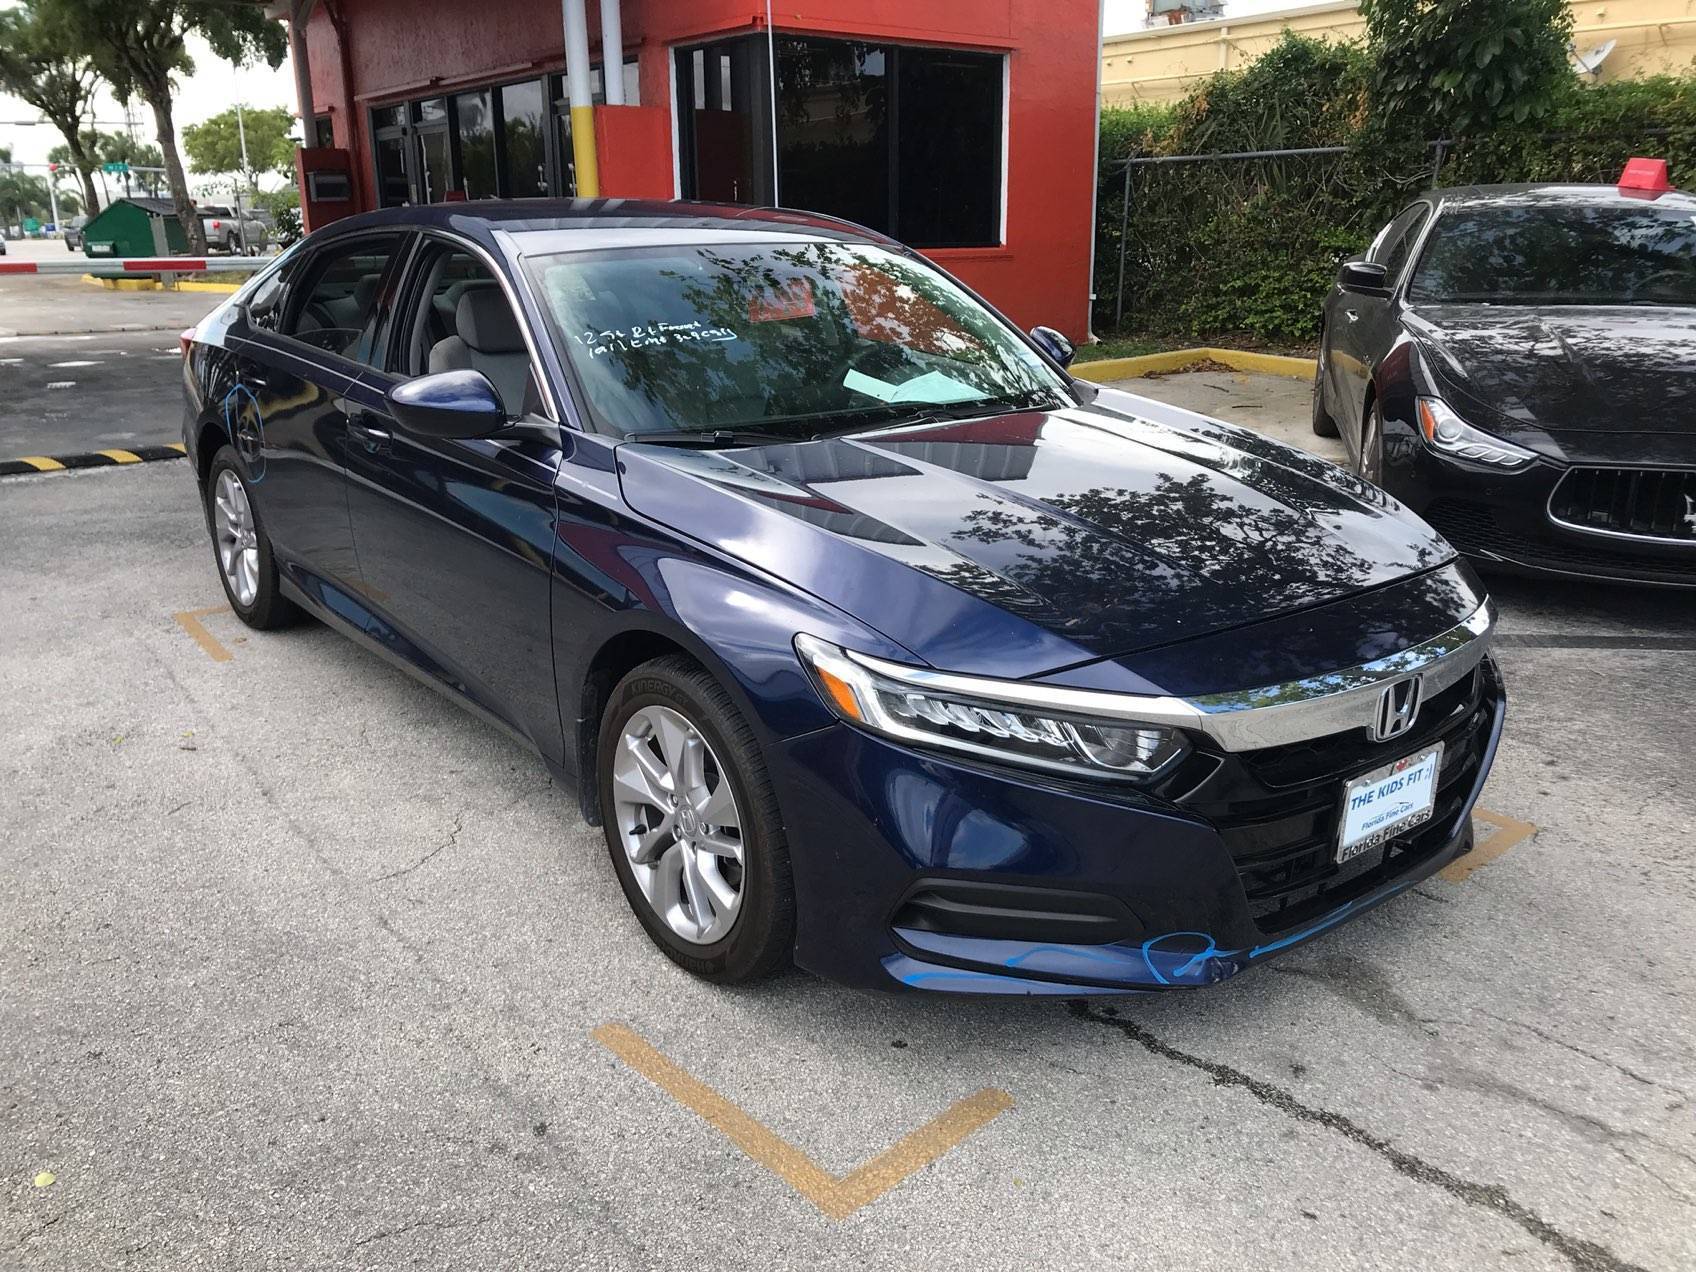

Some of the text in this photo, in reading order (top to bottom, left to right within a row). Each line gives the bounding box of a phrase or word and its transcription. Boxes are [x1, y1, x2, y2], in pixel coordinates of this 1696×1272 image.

[1351, 790, 1376, 810] THE
[1377, 777, 1404, 800] KIDS
[1406, 767, 1424, 787] FIT
[1342, 809, 1431, 860] Florida Fine Cars
[1361, 801, 1414, 831] Florida Fine Cars
